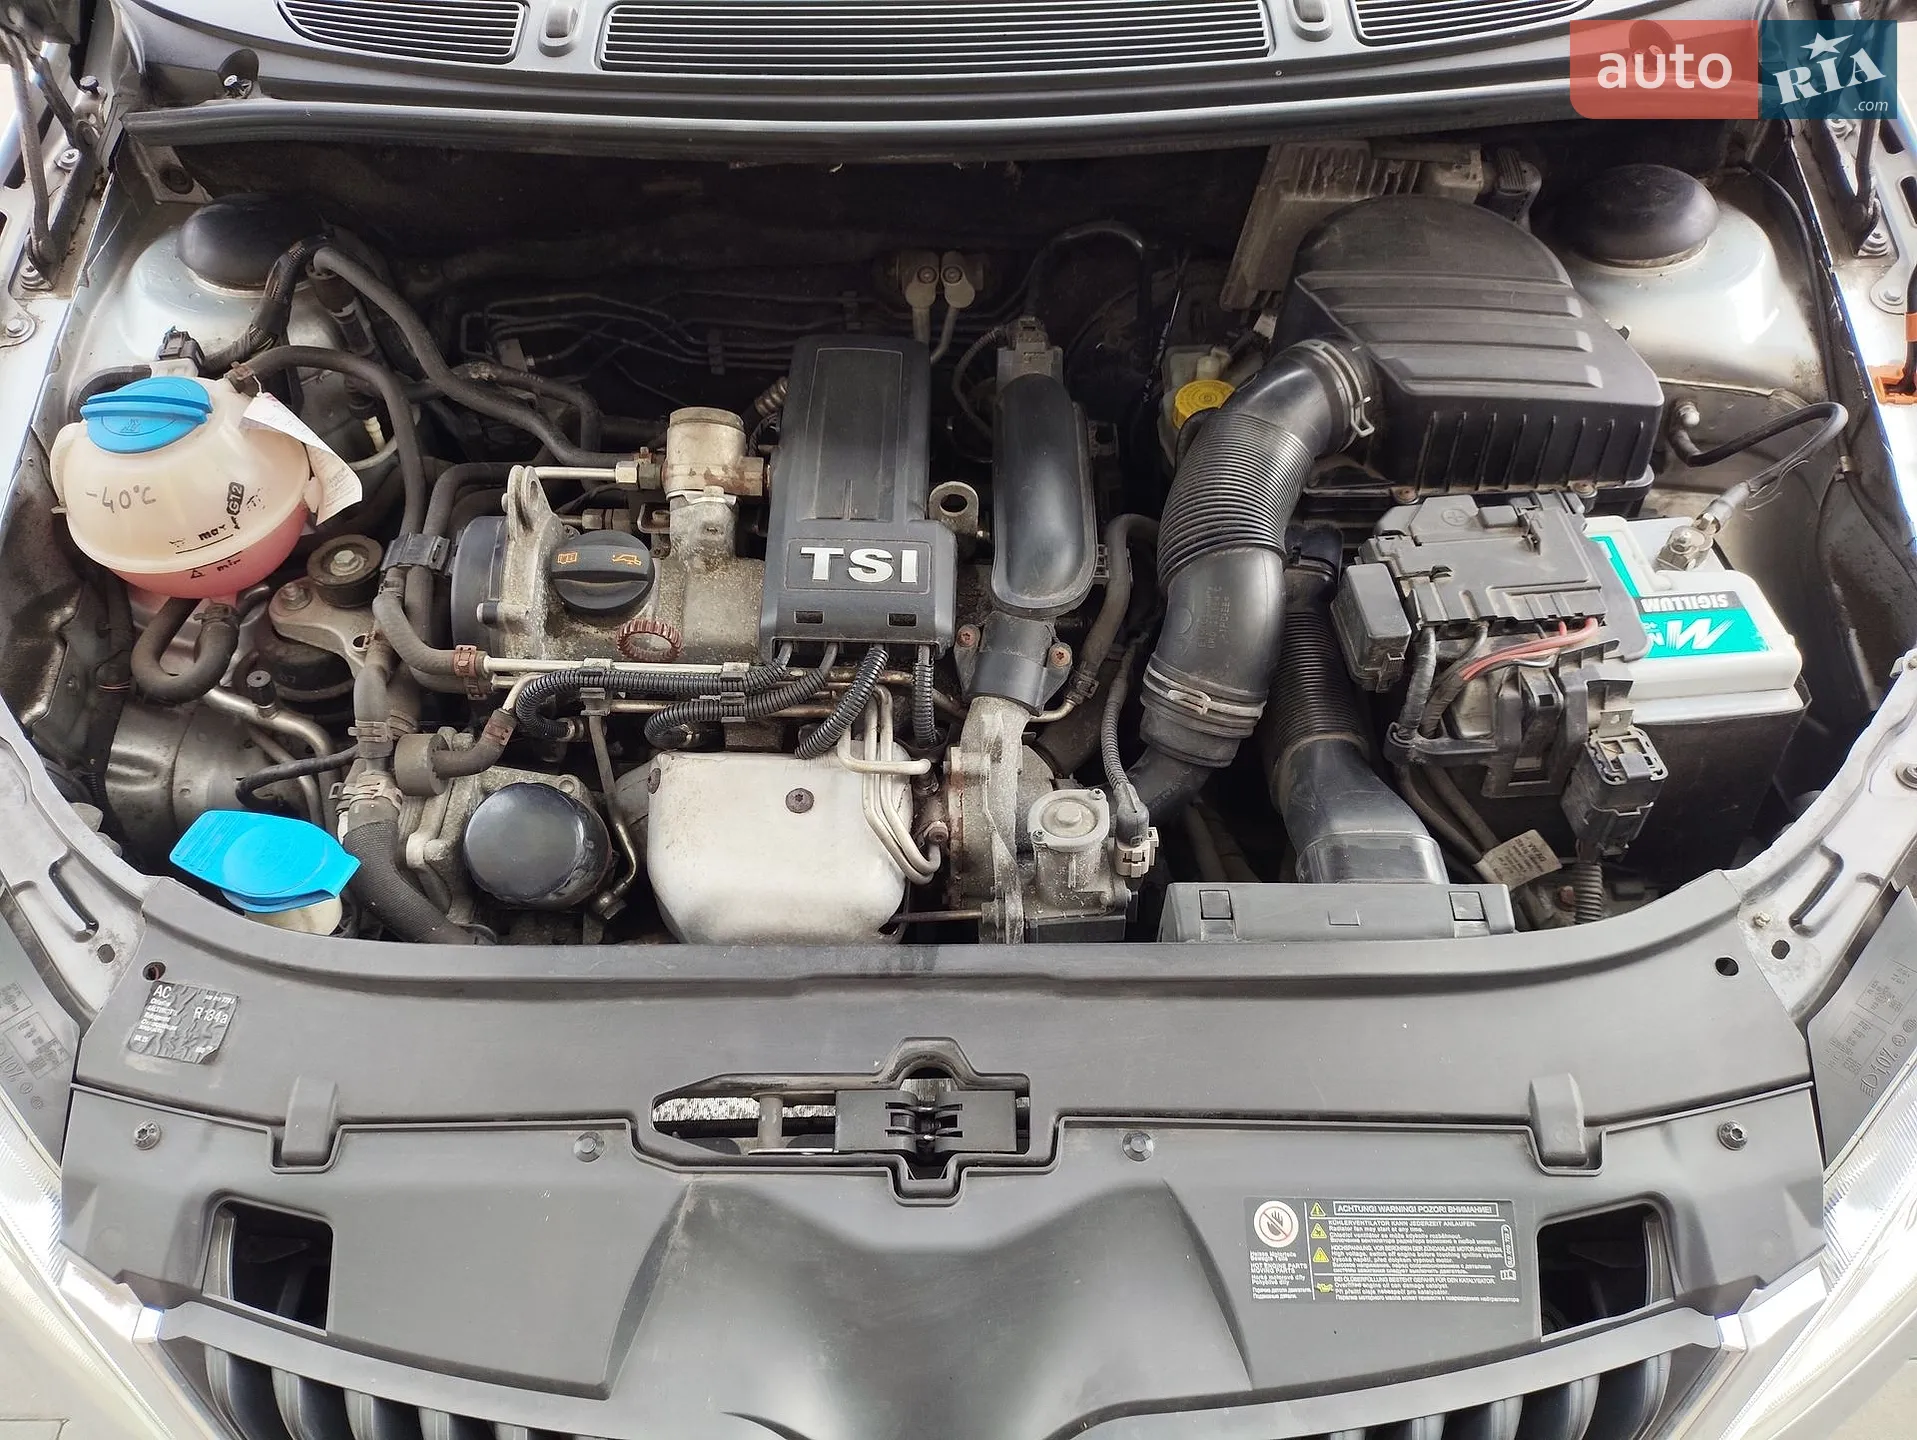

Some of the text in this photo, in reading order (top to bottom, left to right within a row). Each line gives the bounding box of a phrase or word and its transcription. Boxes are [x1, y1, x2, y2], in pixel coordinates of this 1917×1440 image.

[800, 546, 919, 584] TSI
[1641, 593, 1729, 613] SIGILLUM
[153, 984, 172, 999] AC
[1338, 1205, 1492, 1213] ACHTUNG! WARNING! POZOR! ВНИМАНИЕ!
